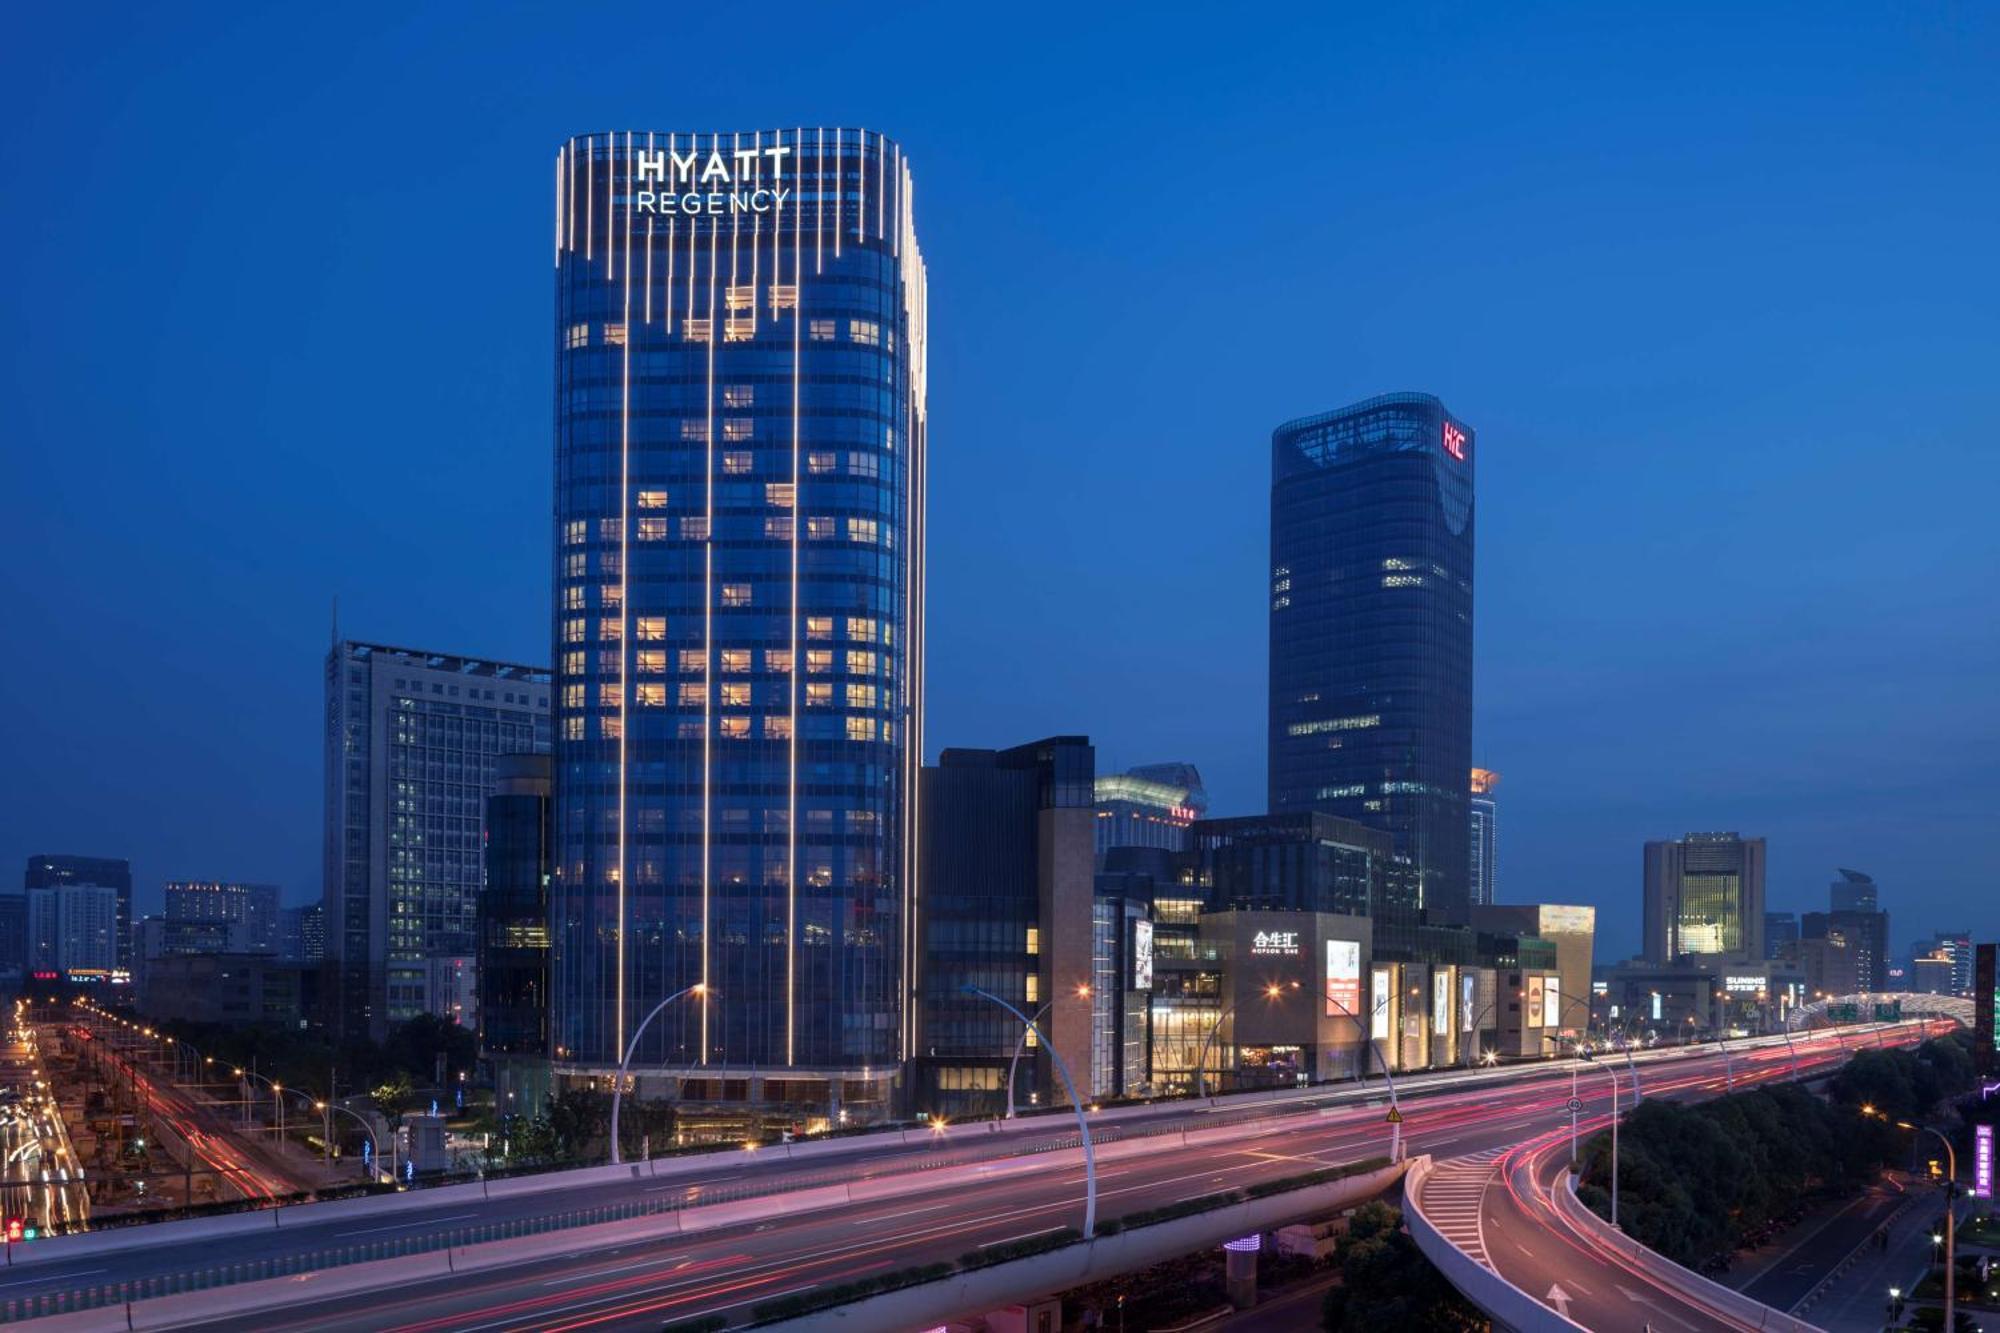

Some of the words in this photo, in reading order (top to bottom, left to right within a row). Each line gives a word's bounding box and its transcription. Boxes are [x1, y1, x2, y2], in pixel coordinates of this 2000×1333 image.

[638, 148, 790, 182] HYATT
[638, 188, 790, 214] REGENCY
[1253, 931, 1298, 947] 合生汇
